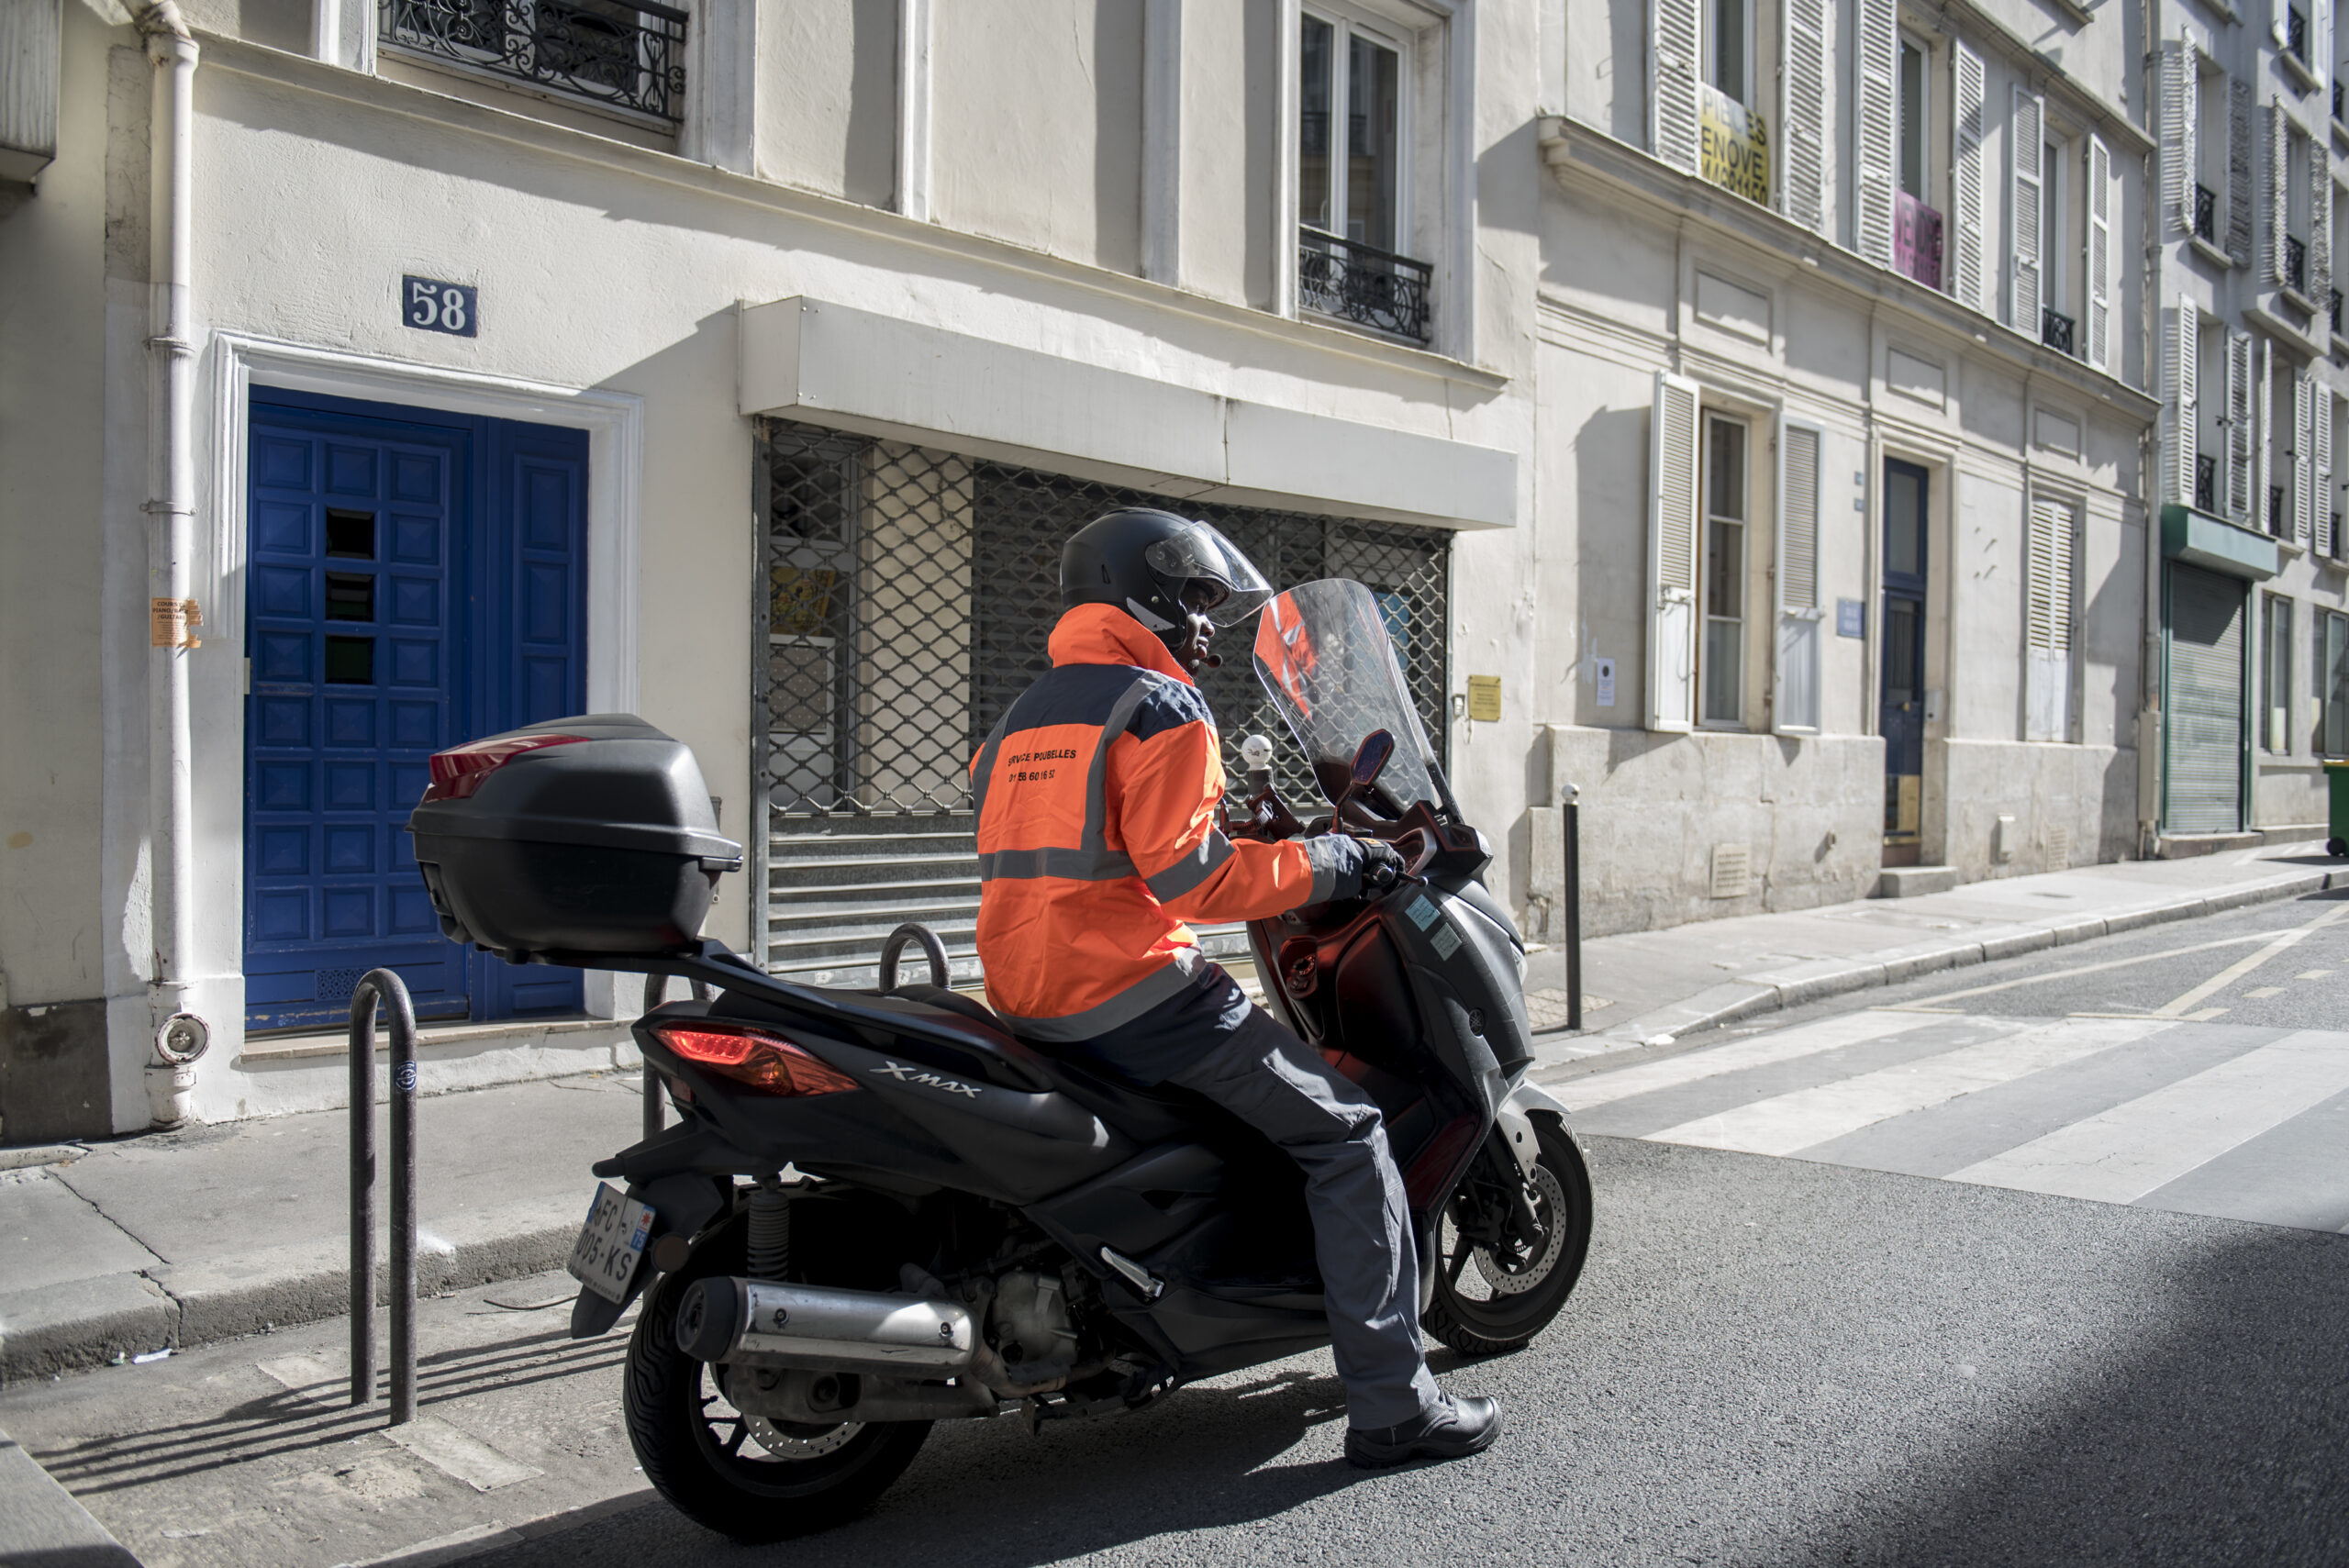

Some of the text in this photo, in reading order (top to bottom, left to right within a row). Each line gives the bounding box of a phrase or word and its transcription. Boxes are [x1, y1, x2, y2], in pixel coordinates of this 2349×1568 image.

[413, 282, 466, 330] 58
[1033, 750, 1076, 762] POUBELLES
[1029, 772, 1040, 781] 60
[632, 1231, 646, 1249] 75
